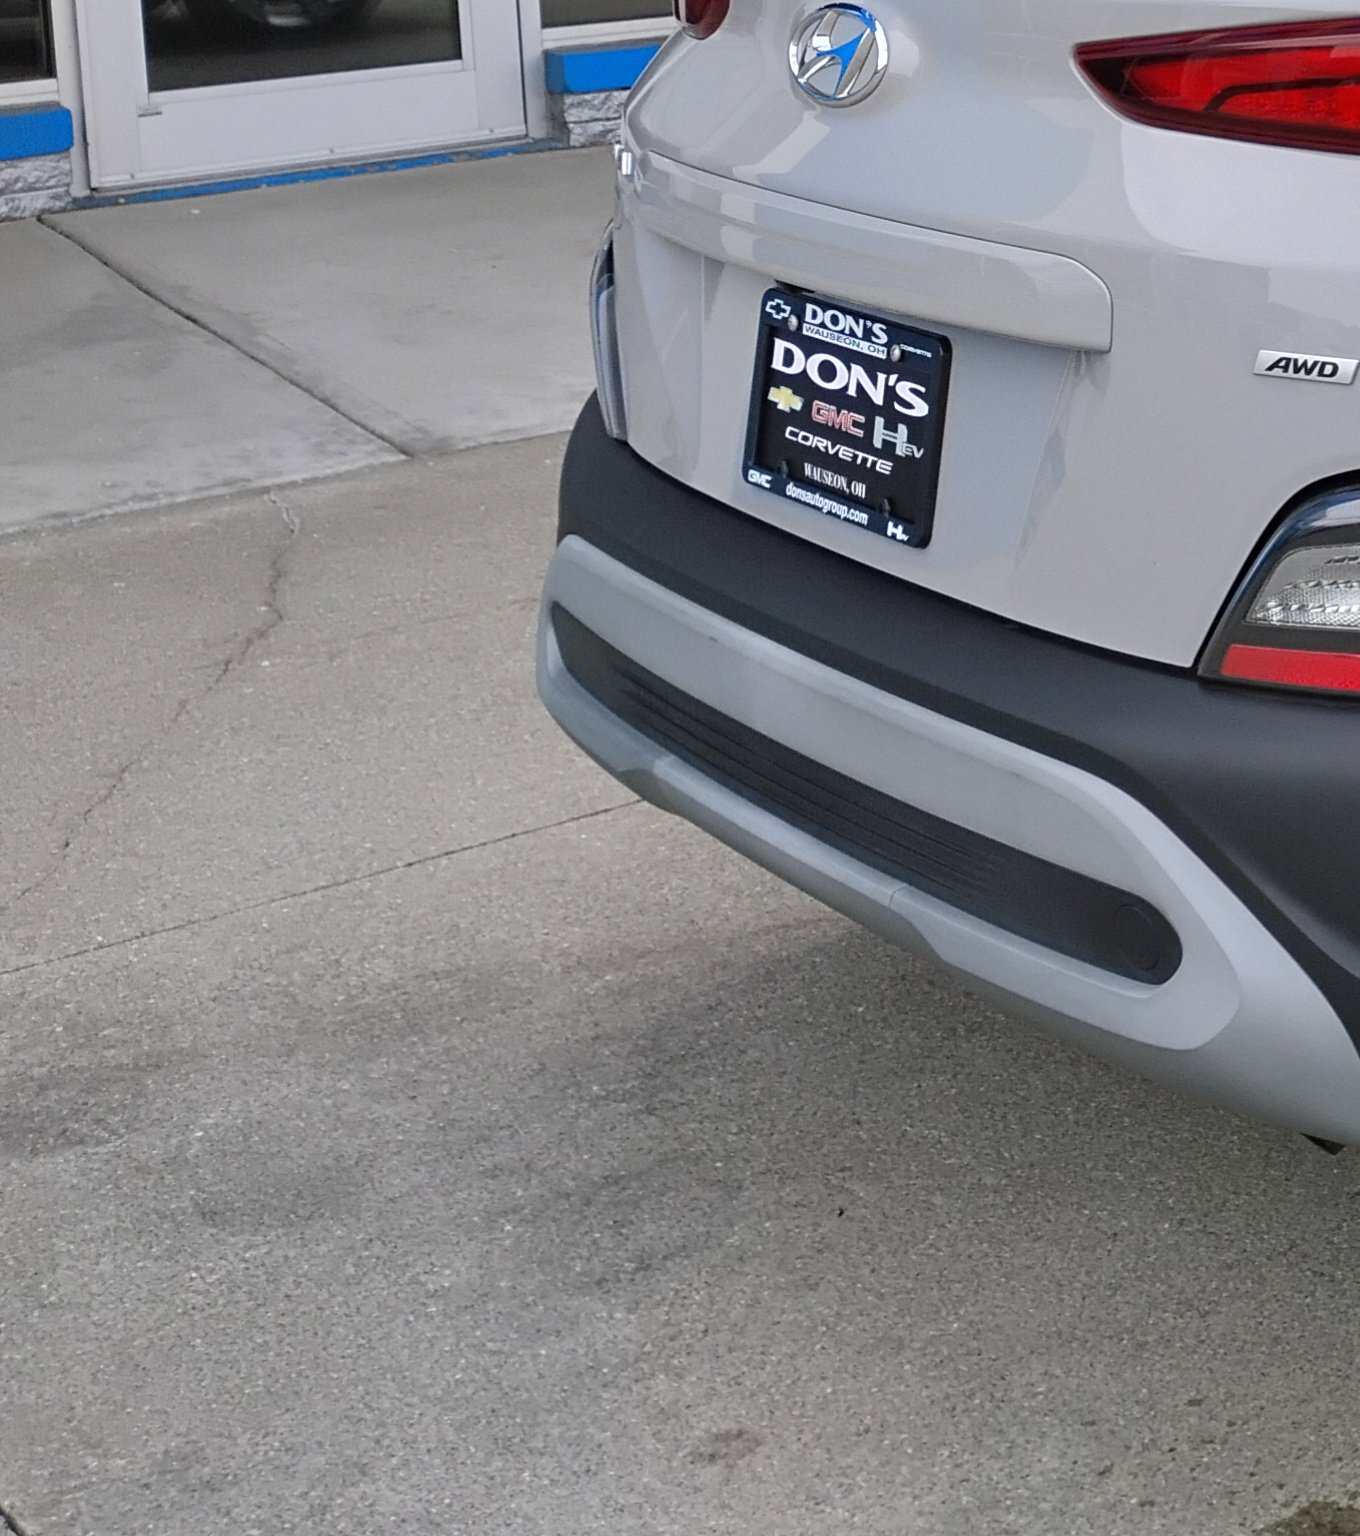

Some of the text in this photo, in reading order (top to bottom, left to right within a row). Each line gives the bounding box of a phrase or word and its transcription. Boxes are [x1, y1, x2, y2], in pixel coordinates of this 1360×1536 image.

[805, 302, 889, 345] DON'S
[805, 325, 886, 355] WAUSEON, OH
[771, 337, 929, 417] DON'S
[1265, 356, 1340, 378] AWD
[812, 400, 866, 438] GMC
[785, 425, 893, 475] CORVETTE
[747, 469, 773, 489] GMC
[804, 462, 866, 499] WAUSEON, OH
[786, 482, 869, 526] donsautogroup.com
